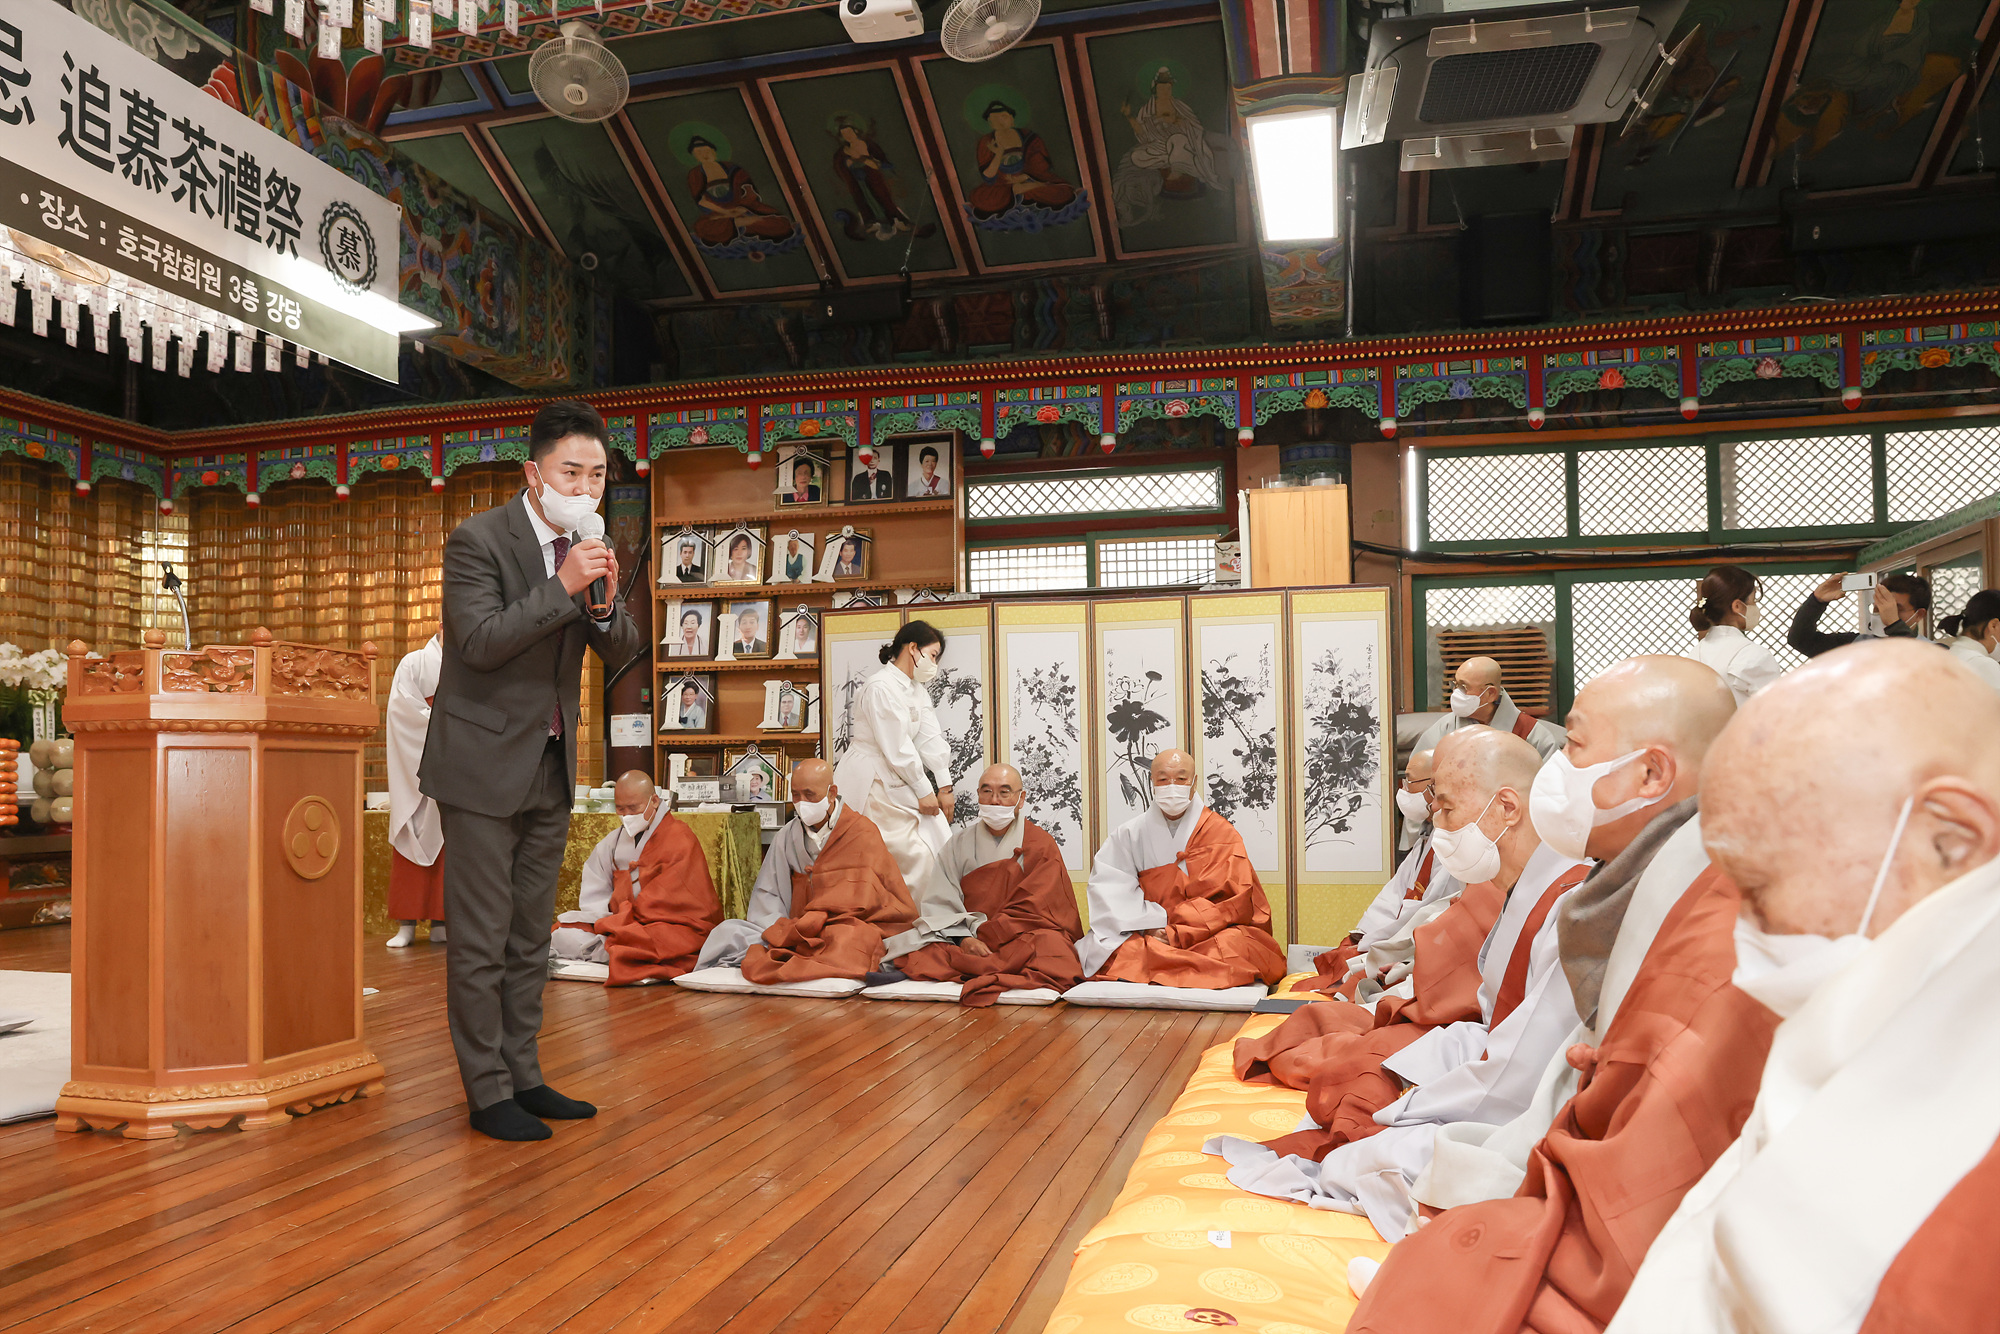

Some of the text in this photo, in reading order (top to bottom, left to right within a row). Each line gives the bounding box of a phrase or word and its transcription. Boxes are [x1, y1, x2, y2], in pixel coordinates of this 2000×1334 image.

[58, 50, 304, 260] 追慕茶禮祭
[39, 190, 89, 241] 장소
[117, 225, 222, 298] 호국참회원
[229, 276, 260, 313] 3층
[266, 291, 303, 330] 강당
[336, 226, 361, 272] 慕
